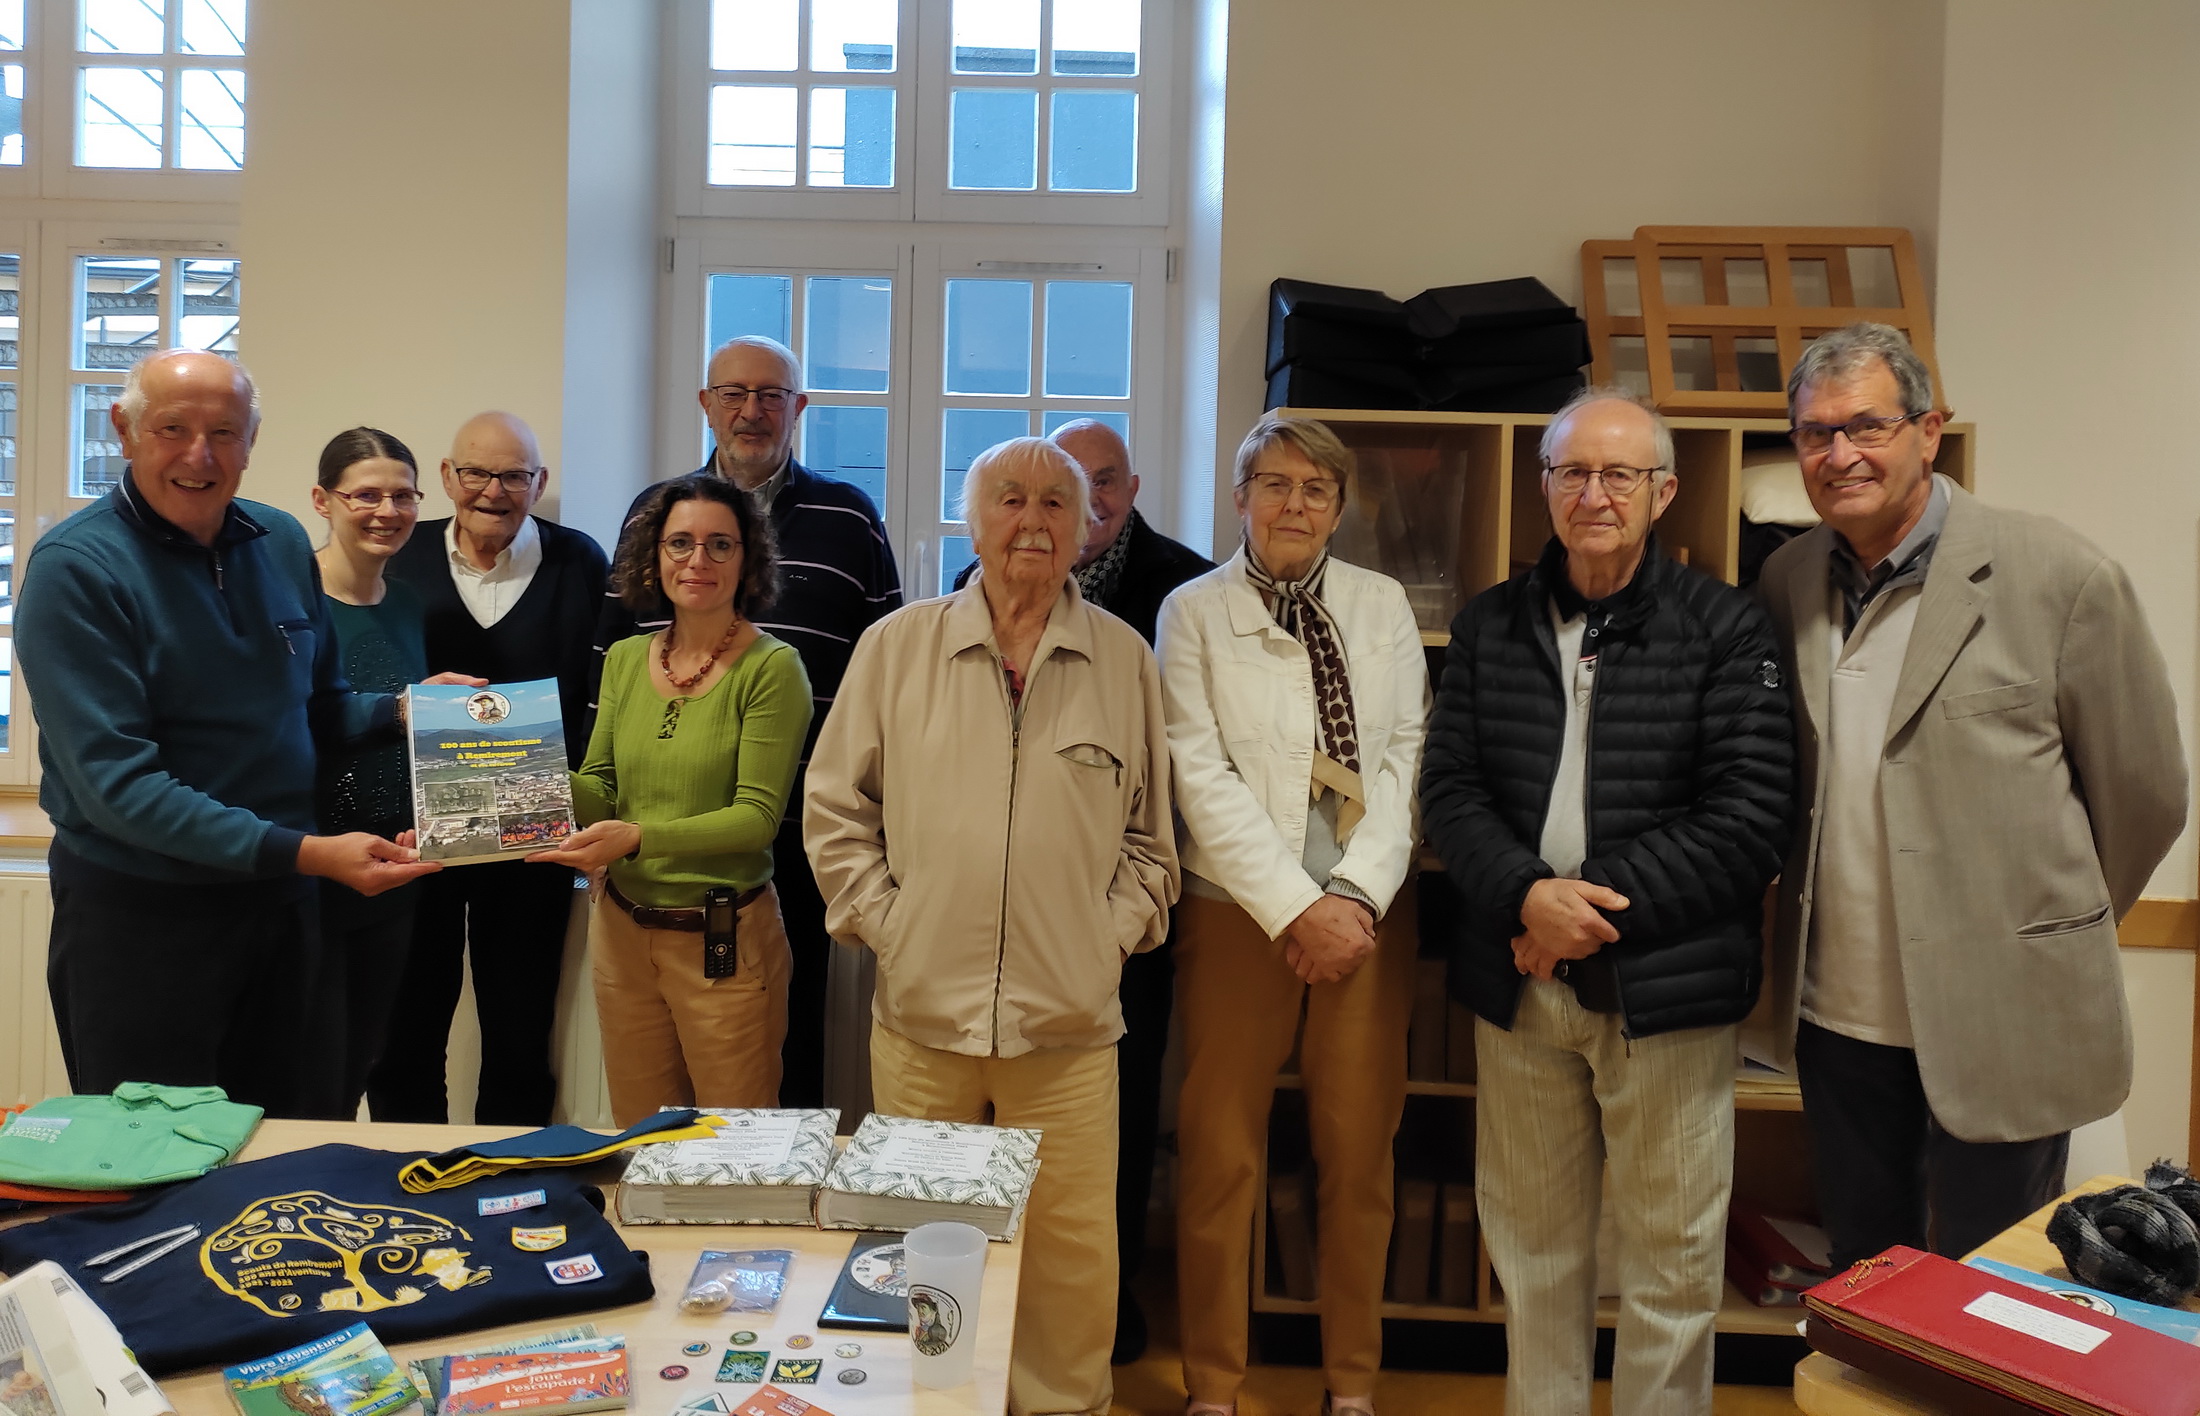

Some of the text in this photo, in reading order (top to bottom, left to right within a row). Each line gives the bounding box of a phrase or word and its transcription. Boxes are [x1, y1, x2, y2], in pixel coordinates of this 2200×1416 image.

[478, 740, 492, 748] de
[492, 739, 542, 747] scoutisme
[464, 750, 528, 760] Remiremont
[272, 1261, 286, 1269] de
[286, 1259, 343, 1269] Remiremont
[258, 1269, 277, 1278] ans
[239, 1361, 277, 1376] Vivre
[528, 1372, 563, 1385] Joue
